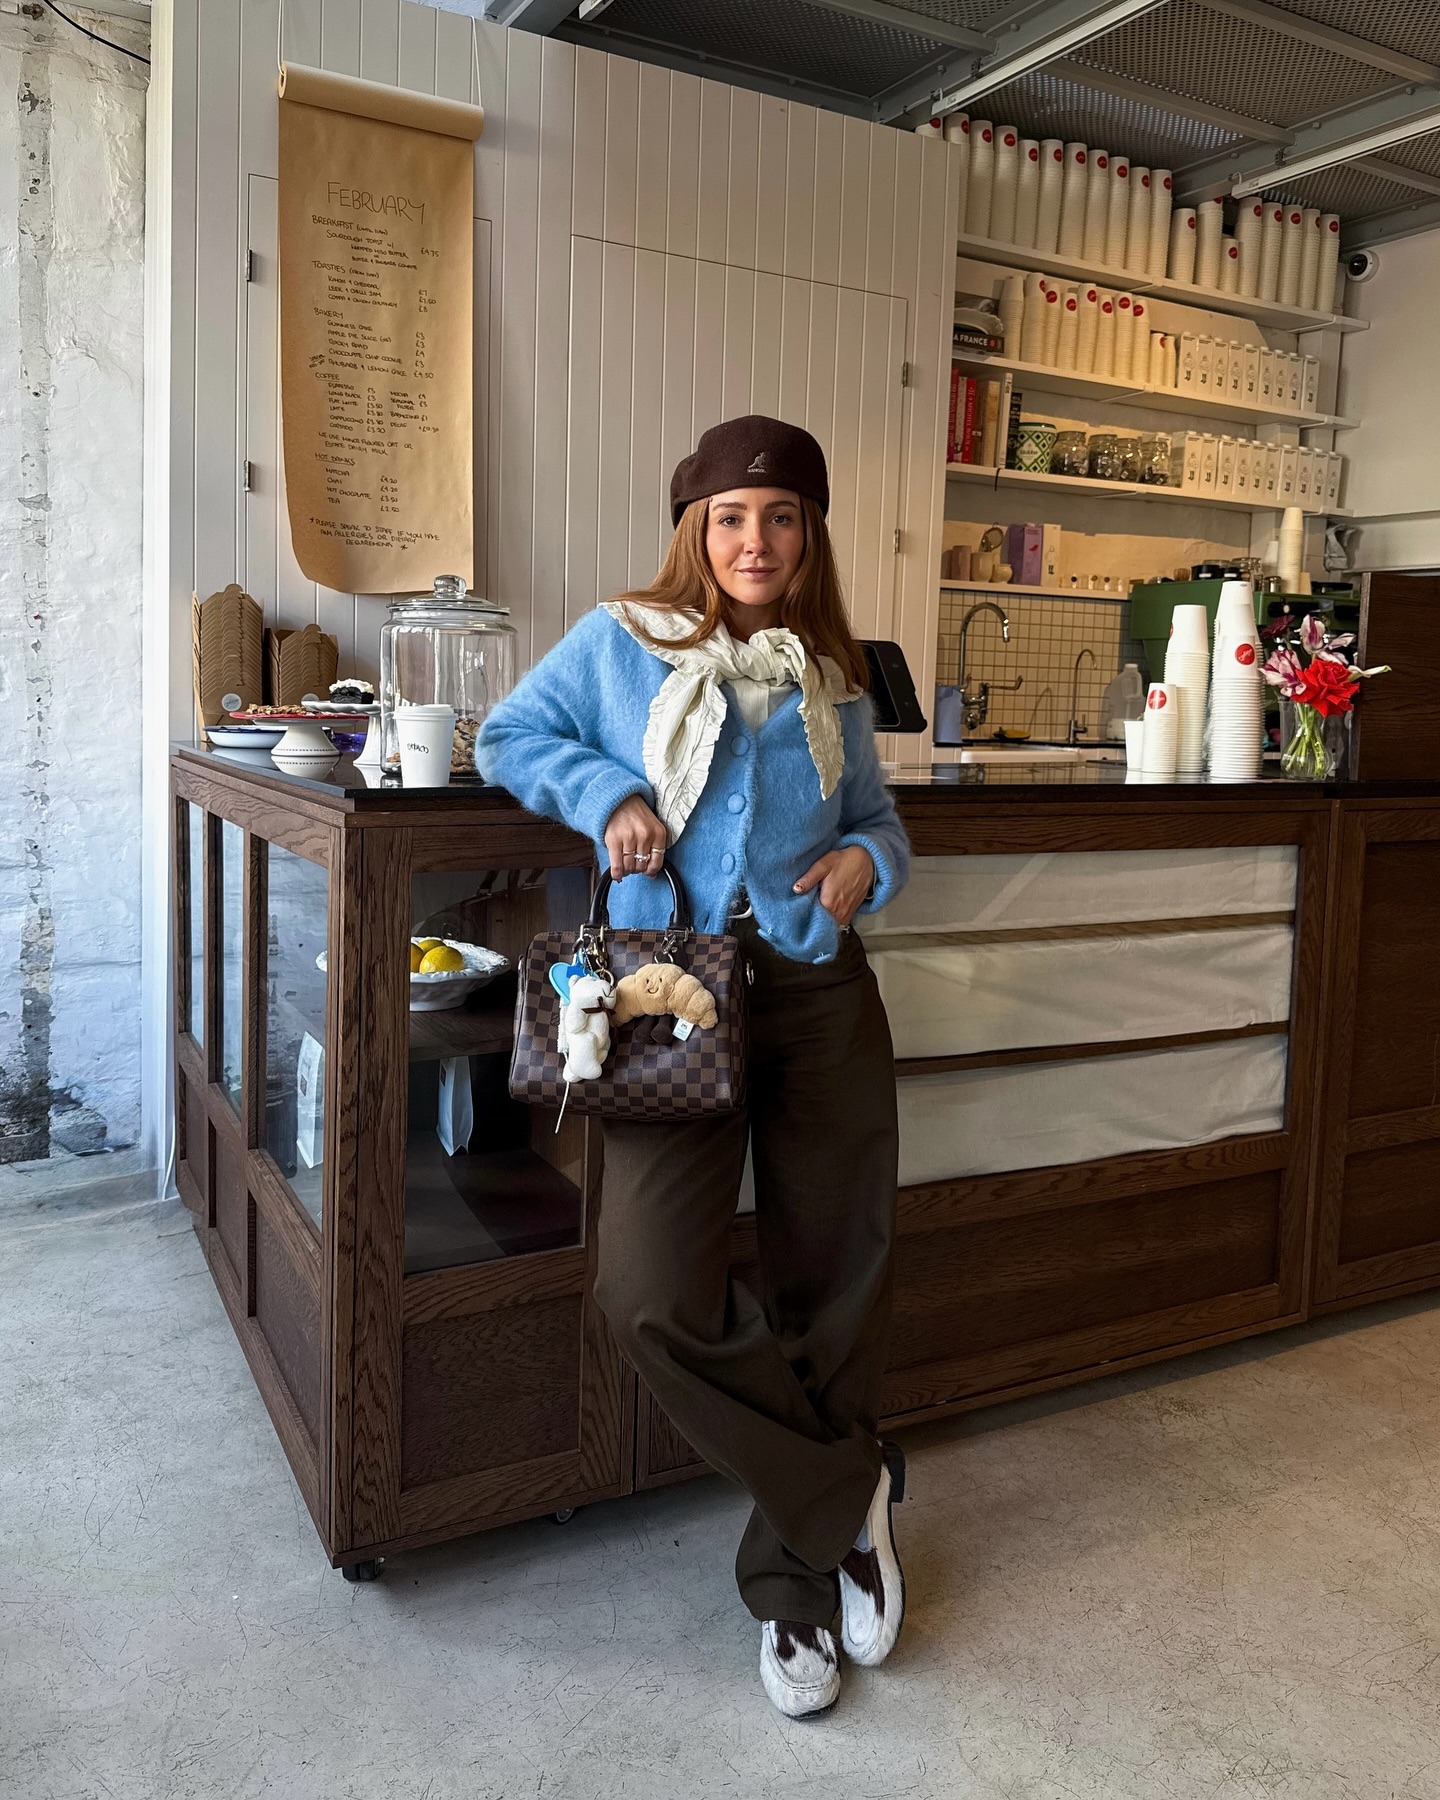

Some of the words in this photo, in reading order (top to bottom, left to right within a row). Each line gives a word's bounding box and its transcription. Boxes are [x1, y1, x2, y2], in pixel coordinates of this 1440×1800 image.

[327, 181, 425, 225] FEBRUARY
[312, 215, 354, 230] BREAKFAST
[326, 229, 362, 242] SOURDOUGH
[388, 250, 409, 259] BUTTER
[312, 261, 346, 273] TOASTIES
[353, 281, 379, 290] CHEDDAR
[313, 307, 343, 319] BAKERY
[415, 331, 425, 340] £3
[960, 334, 988, 346] FRANCE
[328, 338, 349, 347] ROCKY
[415, 340, 425, 348] £3
[328, 348, 363, 358] CHOCOLATE
[328, 358, 358, 370] RHUBARB
[414, 360, 424, 368] £3
[315, 372, 340, 380] COFFEE
[329, 422, 353, 431] CORTADO
[314, 452, 328, 460] HOT
[331, 456, 355, 465] DRINKS
[325, 467, 350, 476] MATCHA
[339, 489, 371, 499] CHOCOLATE
[327, 496, 341, 504] TEA
[340, 523, 360, 531] SPEAK
[406, 531, 422, 539] YOU
[334, 529, 373, 540] ALLERGIES
[391, 535, 416, 544] DIETARY
